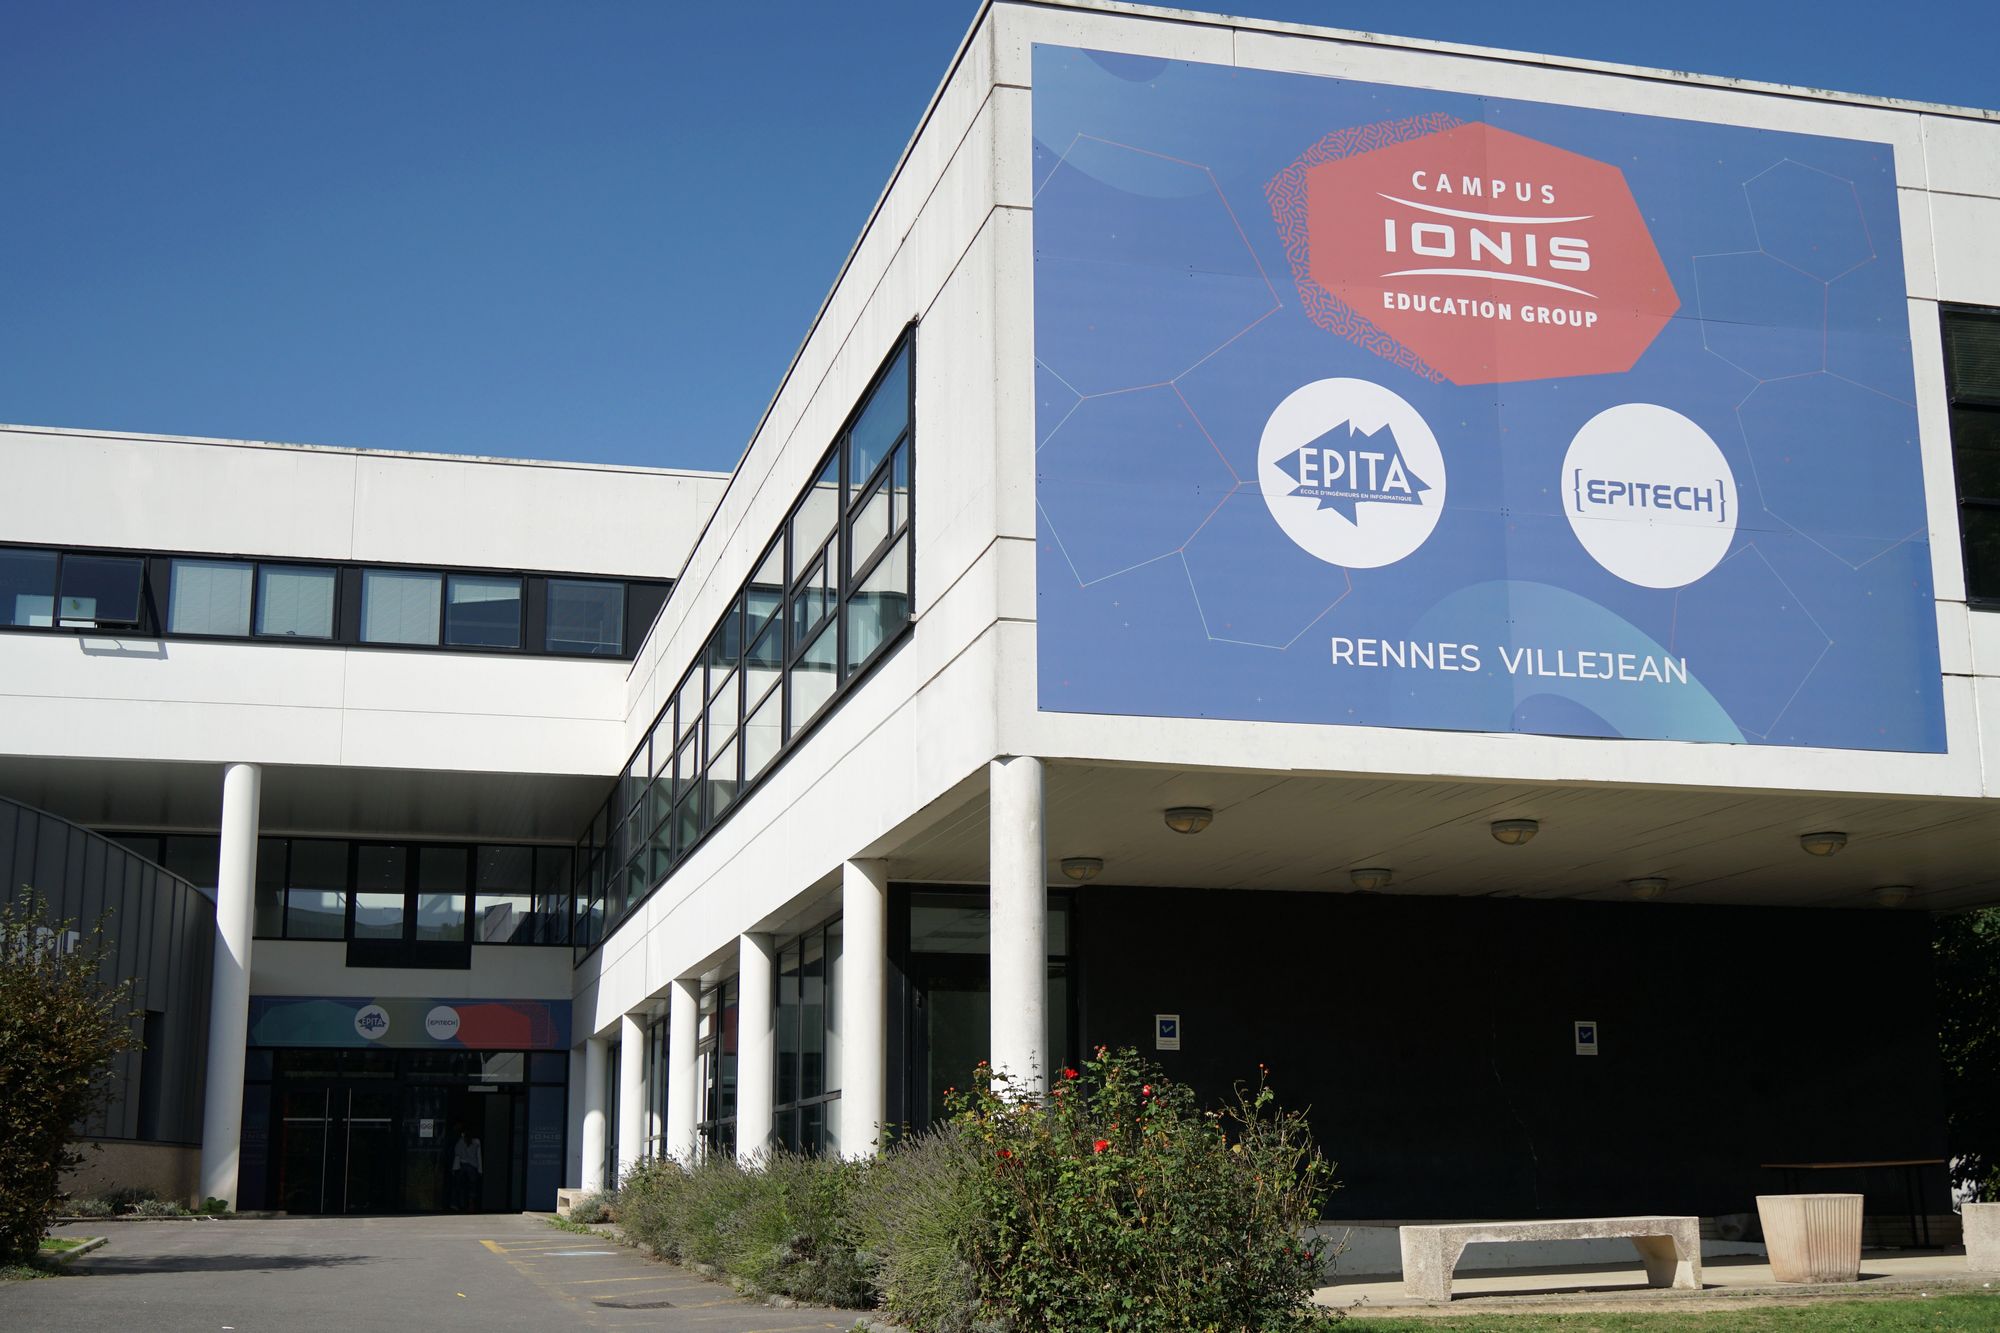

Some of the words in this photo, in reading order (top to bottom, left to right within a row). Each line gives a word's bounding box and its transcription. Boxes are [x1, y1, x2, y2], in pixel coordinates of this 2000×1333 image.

[1412, 171, 1555, 204] CAMPUS
[1385, 219, 1590, 272] IONIS
[1384, 292, 1512, 320] EDUCATION
[1521, 306, 1598, 328] GROUP
[1300, 447, 1412, 493] EPITA
[1370, 494, 1412, 502] INFORMATIQUE
[1331, 637, 1481, 672] RENNES
[1498, 646, 1687, 684] VILLEJEAN
[361, 1017, 384, 1026] EPITA
